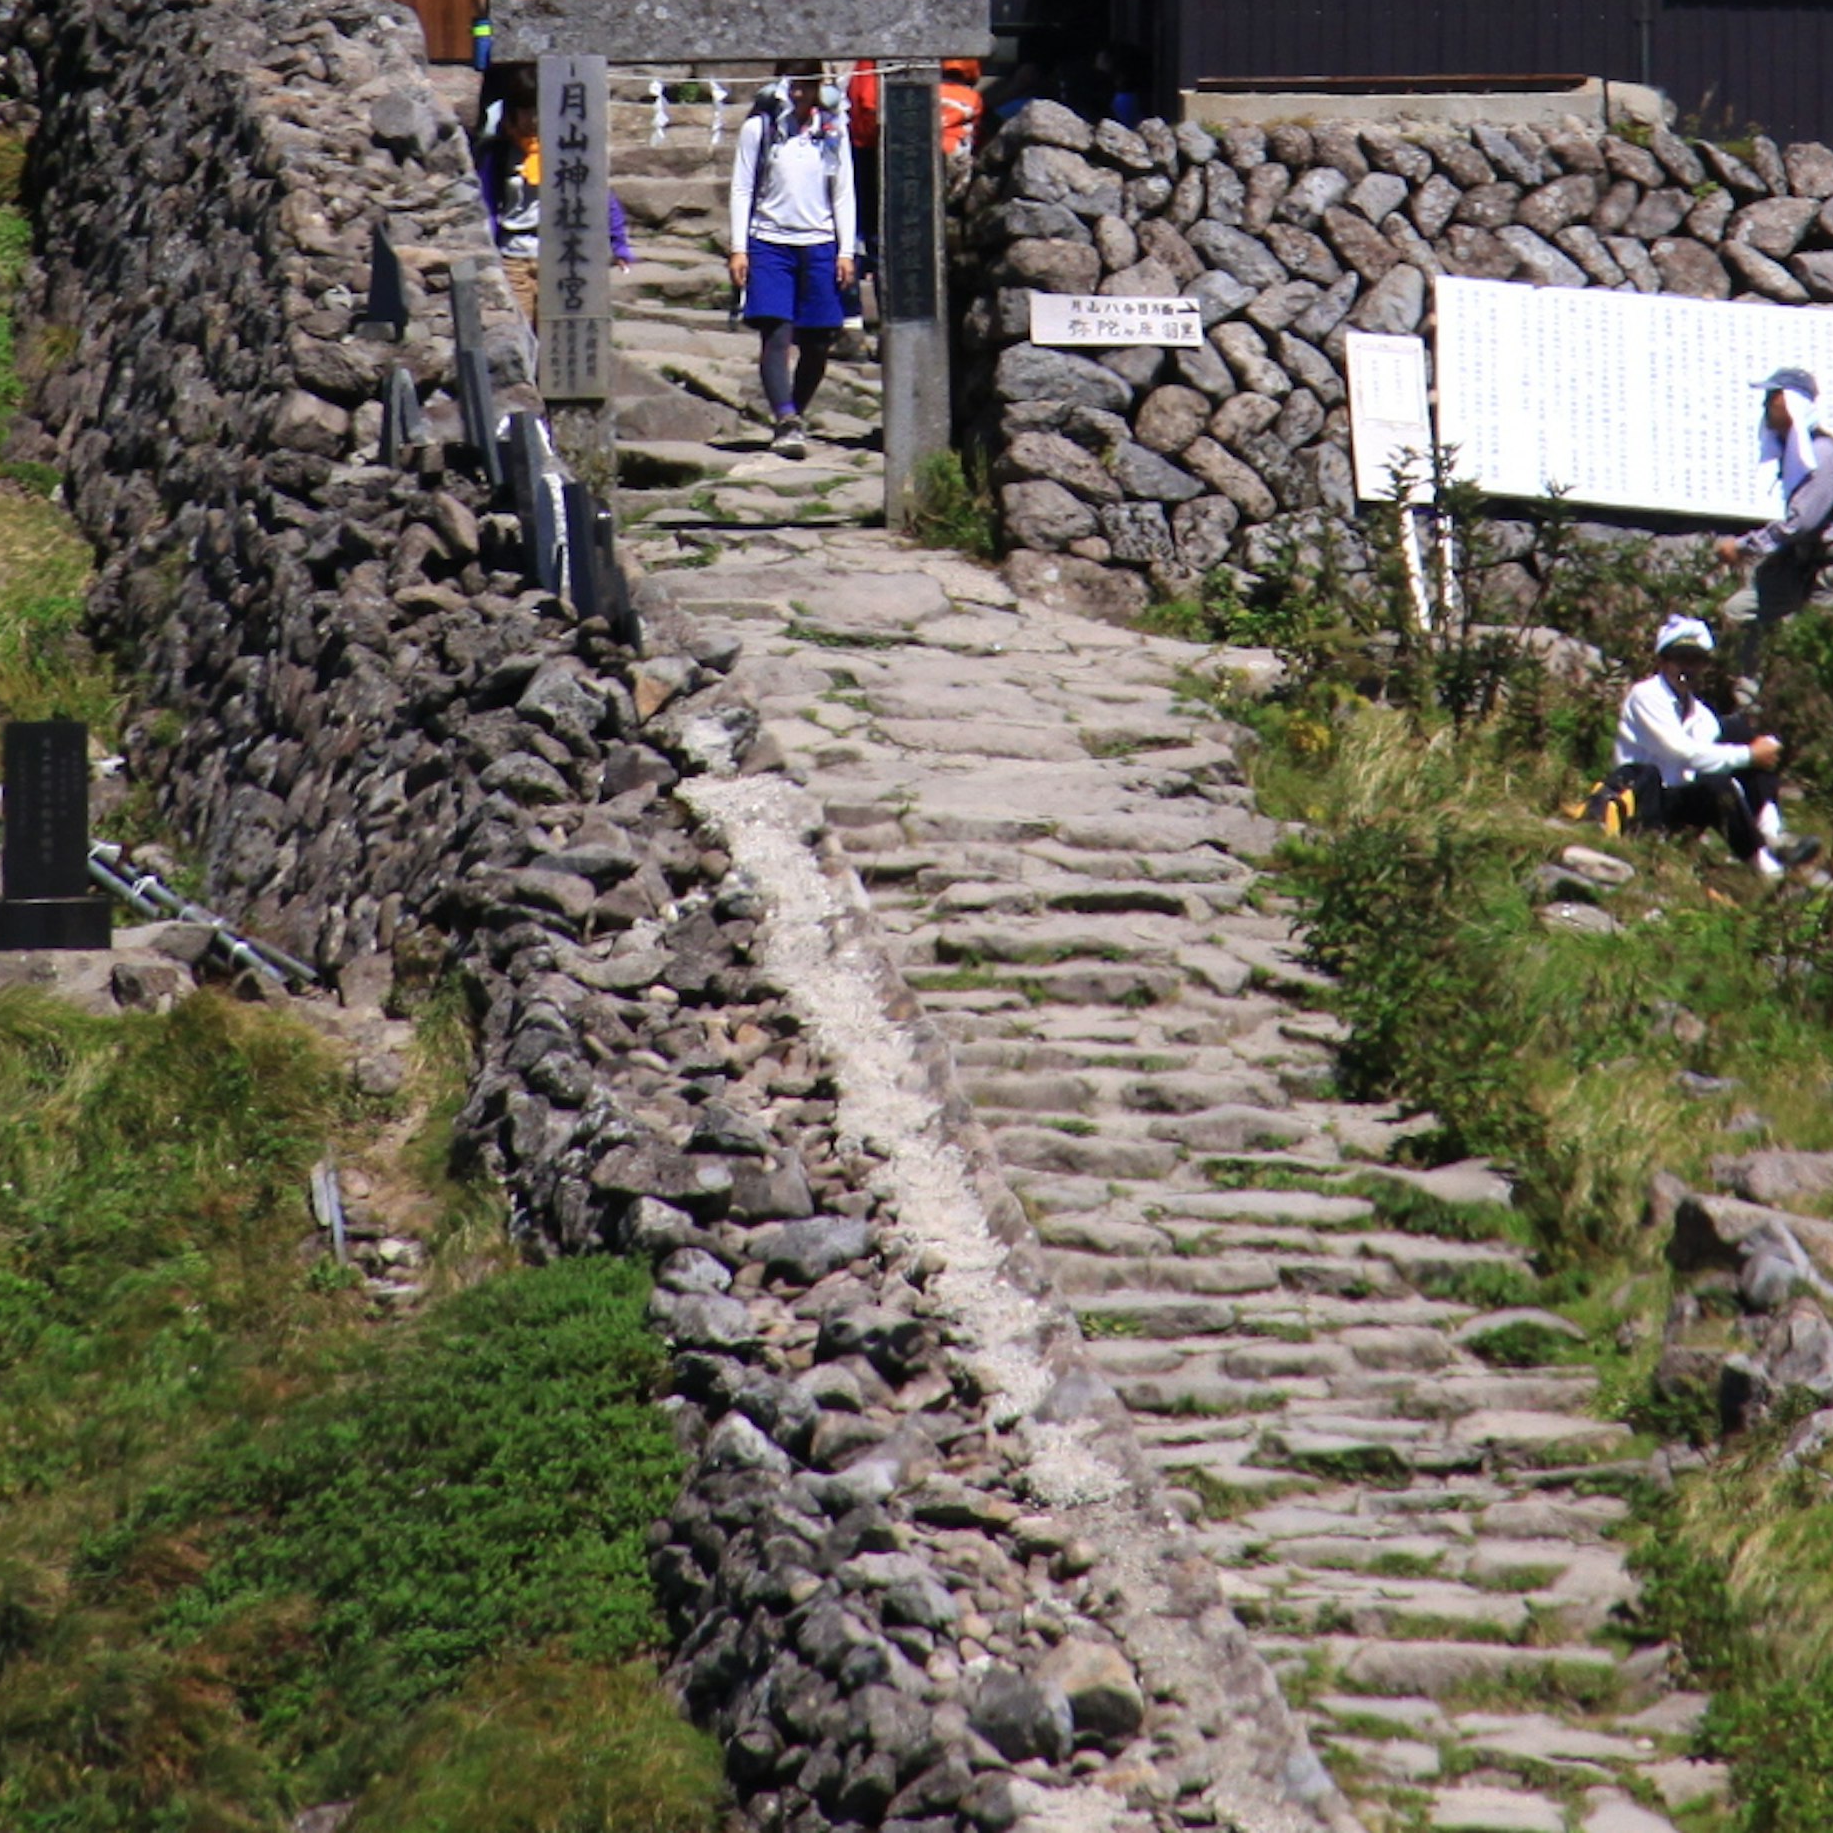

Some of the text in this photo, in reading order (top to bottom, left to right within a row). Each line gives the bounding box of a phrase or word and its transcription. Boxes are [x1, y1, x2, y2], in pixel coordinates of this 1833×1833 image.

[552, 82, 591, 311] 月山神社本宮
